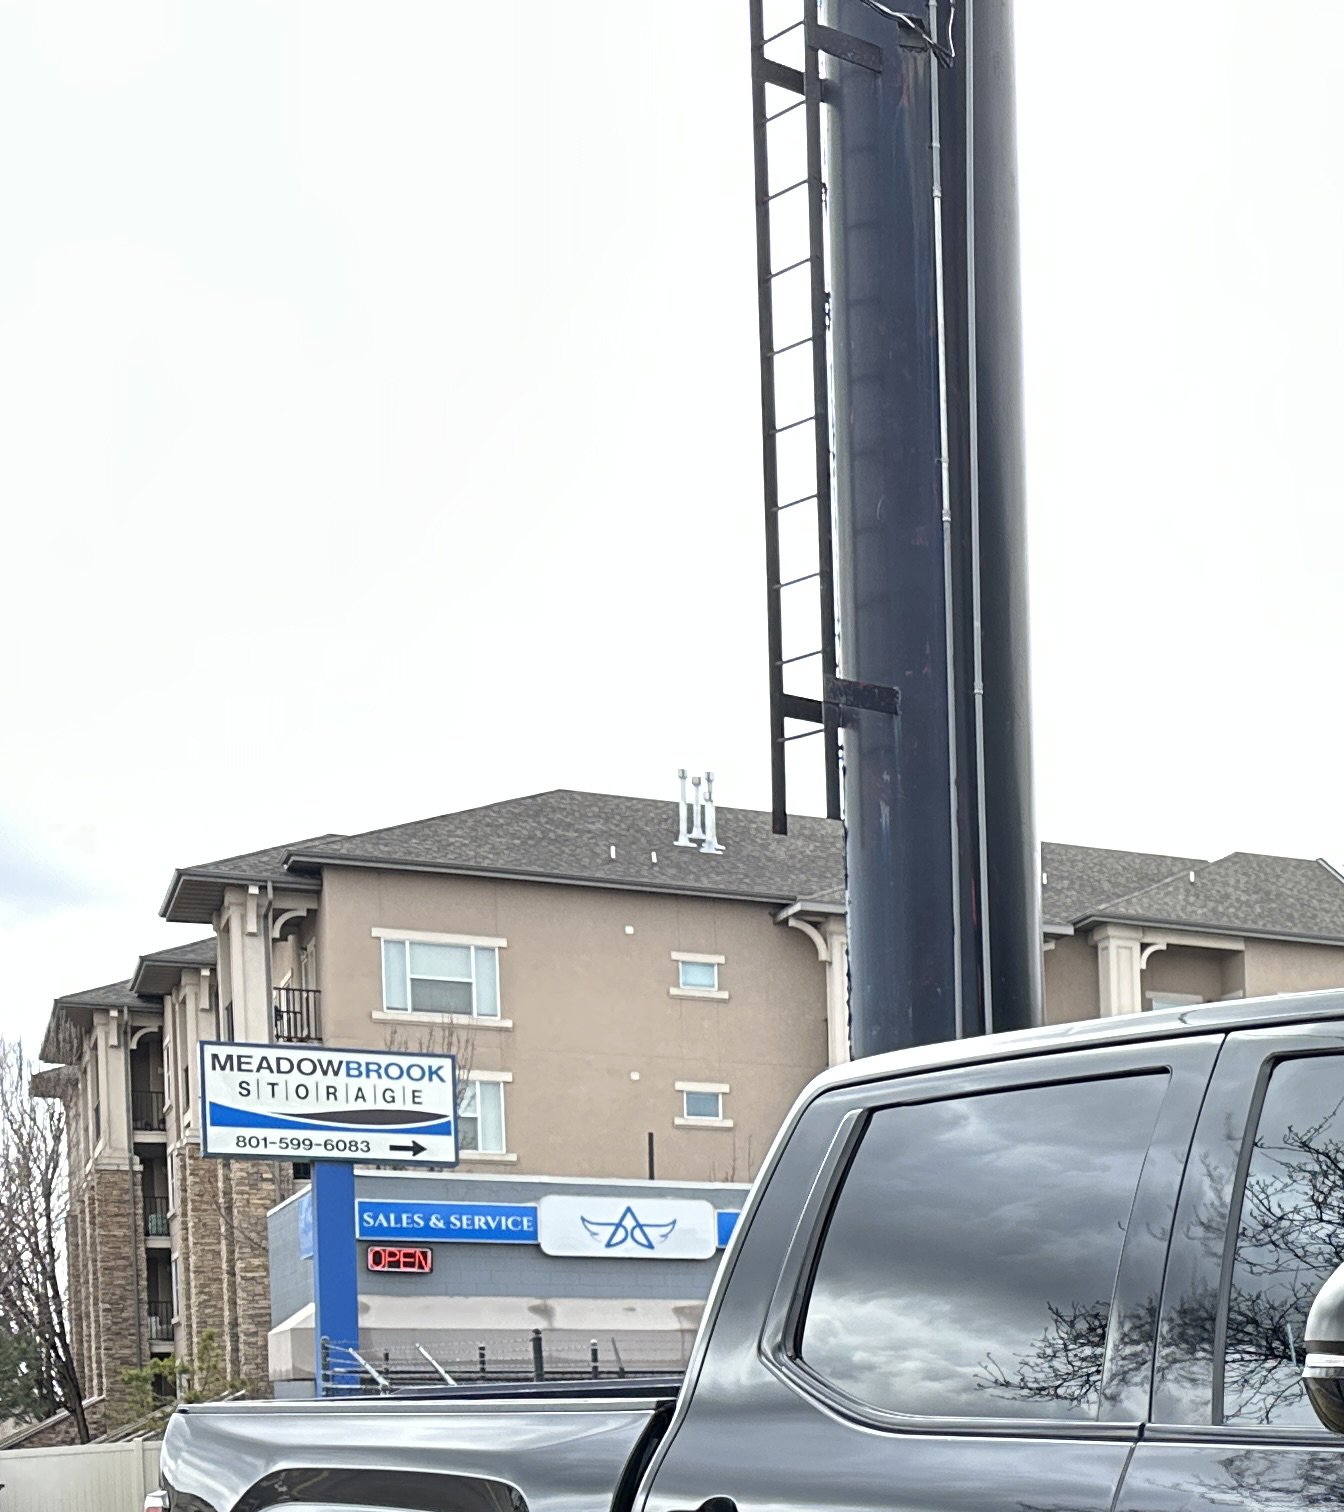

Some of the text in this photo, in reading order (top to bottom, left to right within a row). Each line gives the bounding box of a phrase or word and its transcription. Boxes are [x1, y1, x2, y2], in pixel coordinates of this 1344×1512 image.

[210, 1053, 447, 1083] MEADOWBROOK
[235, 1135, 371, 1153] 801-599-6083
[363, 1212, 534, 1231] SALES & SERVICE
[370, 1248, 430, 1271] OPEN
